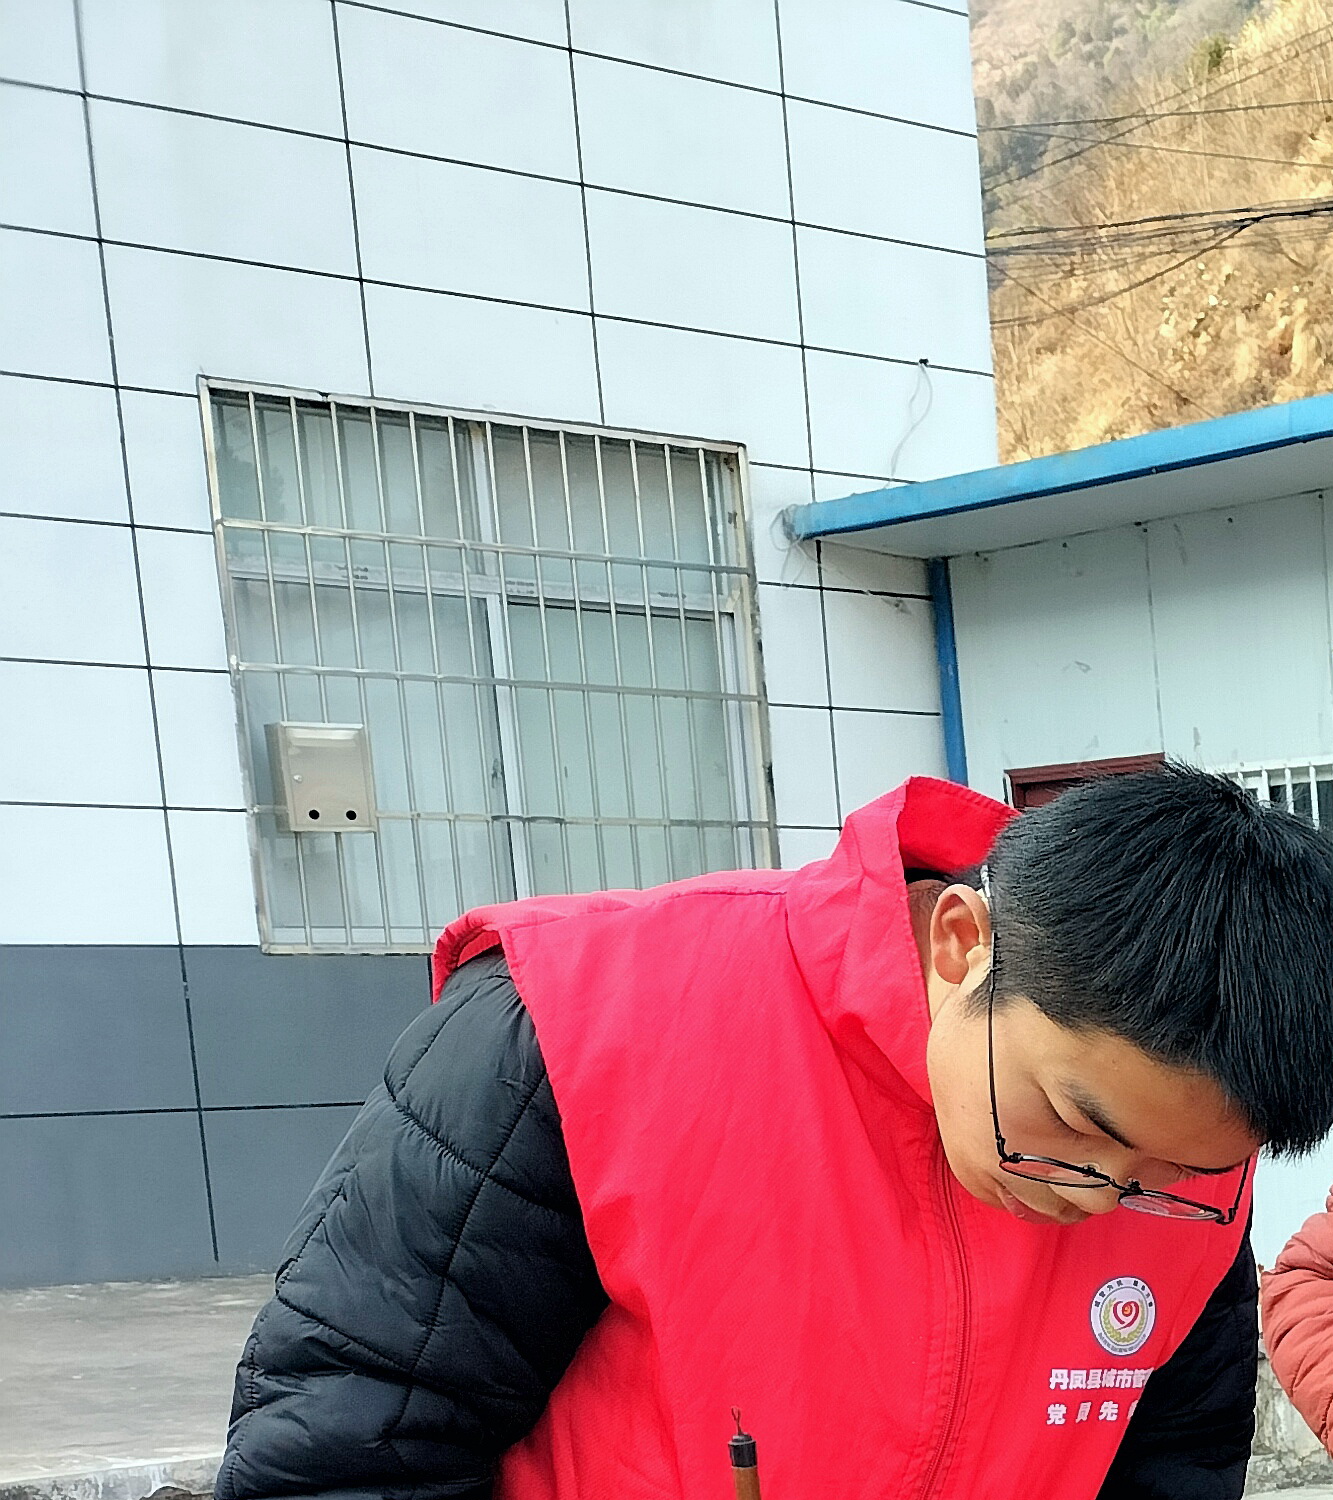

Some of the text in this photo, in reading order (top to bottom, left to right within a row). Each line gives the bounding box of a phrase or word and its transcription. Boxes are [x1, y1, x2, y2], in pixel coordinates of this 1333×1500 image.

[1049, 1367, 1154, 1390] 丹凤县城市管
